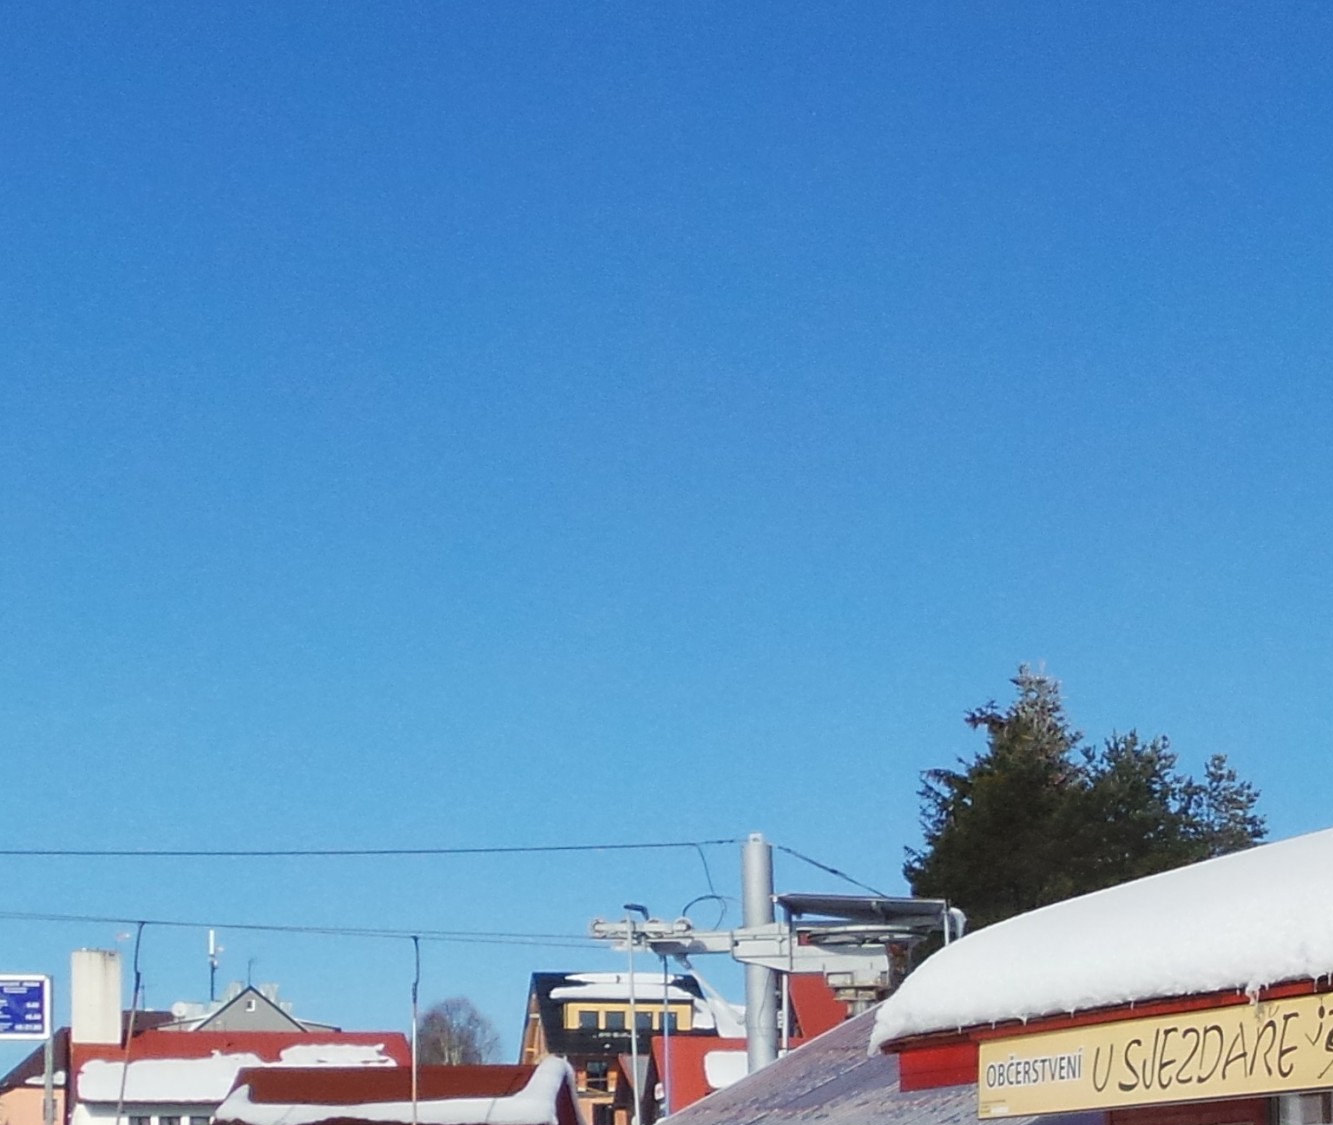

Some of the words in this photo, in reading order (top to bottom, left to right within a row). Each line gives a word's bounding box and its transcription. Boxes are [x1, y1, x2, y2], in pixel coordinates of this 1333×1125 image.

[985, 1047, 1082, 1088] OBČERSTVENÍ
[1092, 1044, 1114, 1092] U
[1118, 1004, 1300, 1093] SJEZDAŘE
